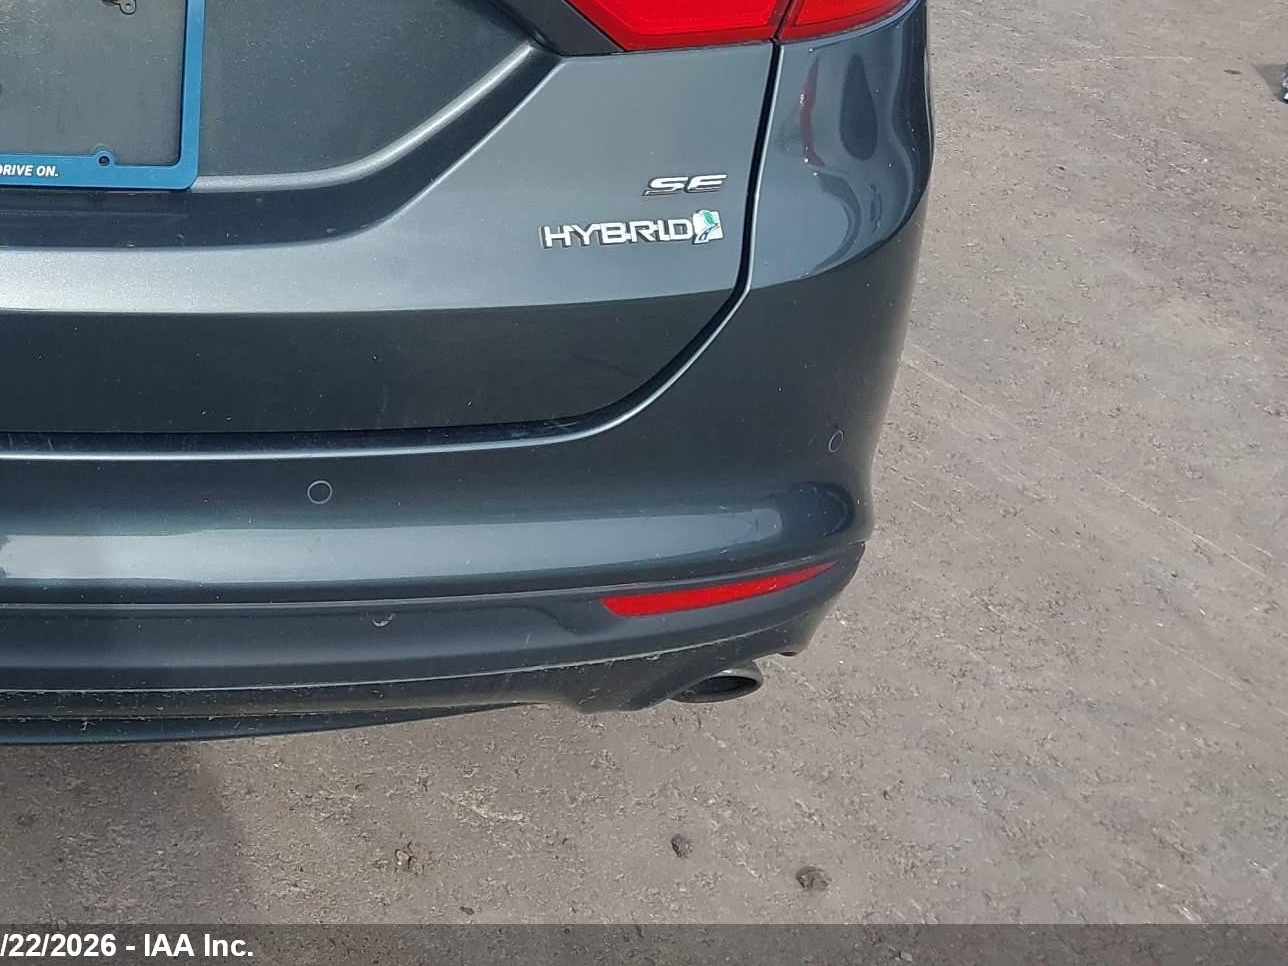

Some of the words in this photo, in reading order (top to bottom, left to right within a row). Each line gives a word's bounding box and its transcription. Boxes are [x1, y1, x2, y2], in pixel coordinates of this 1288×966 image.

[36, 165, 59, 177] ON.
[642, 173, 727, 196] SE
[540, 218, 694, 249] HYBRID
